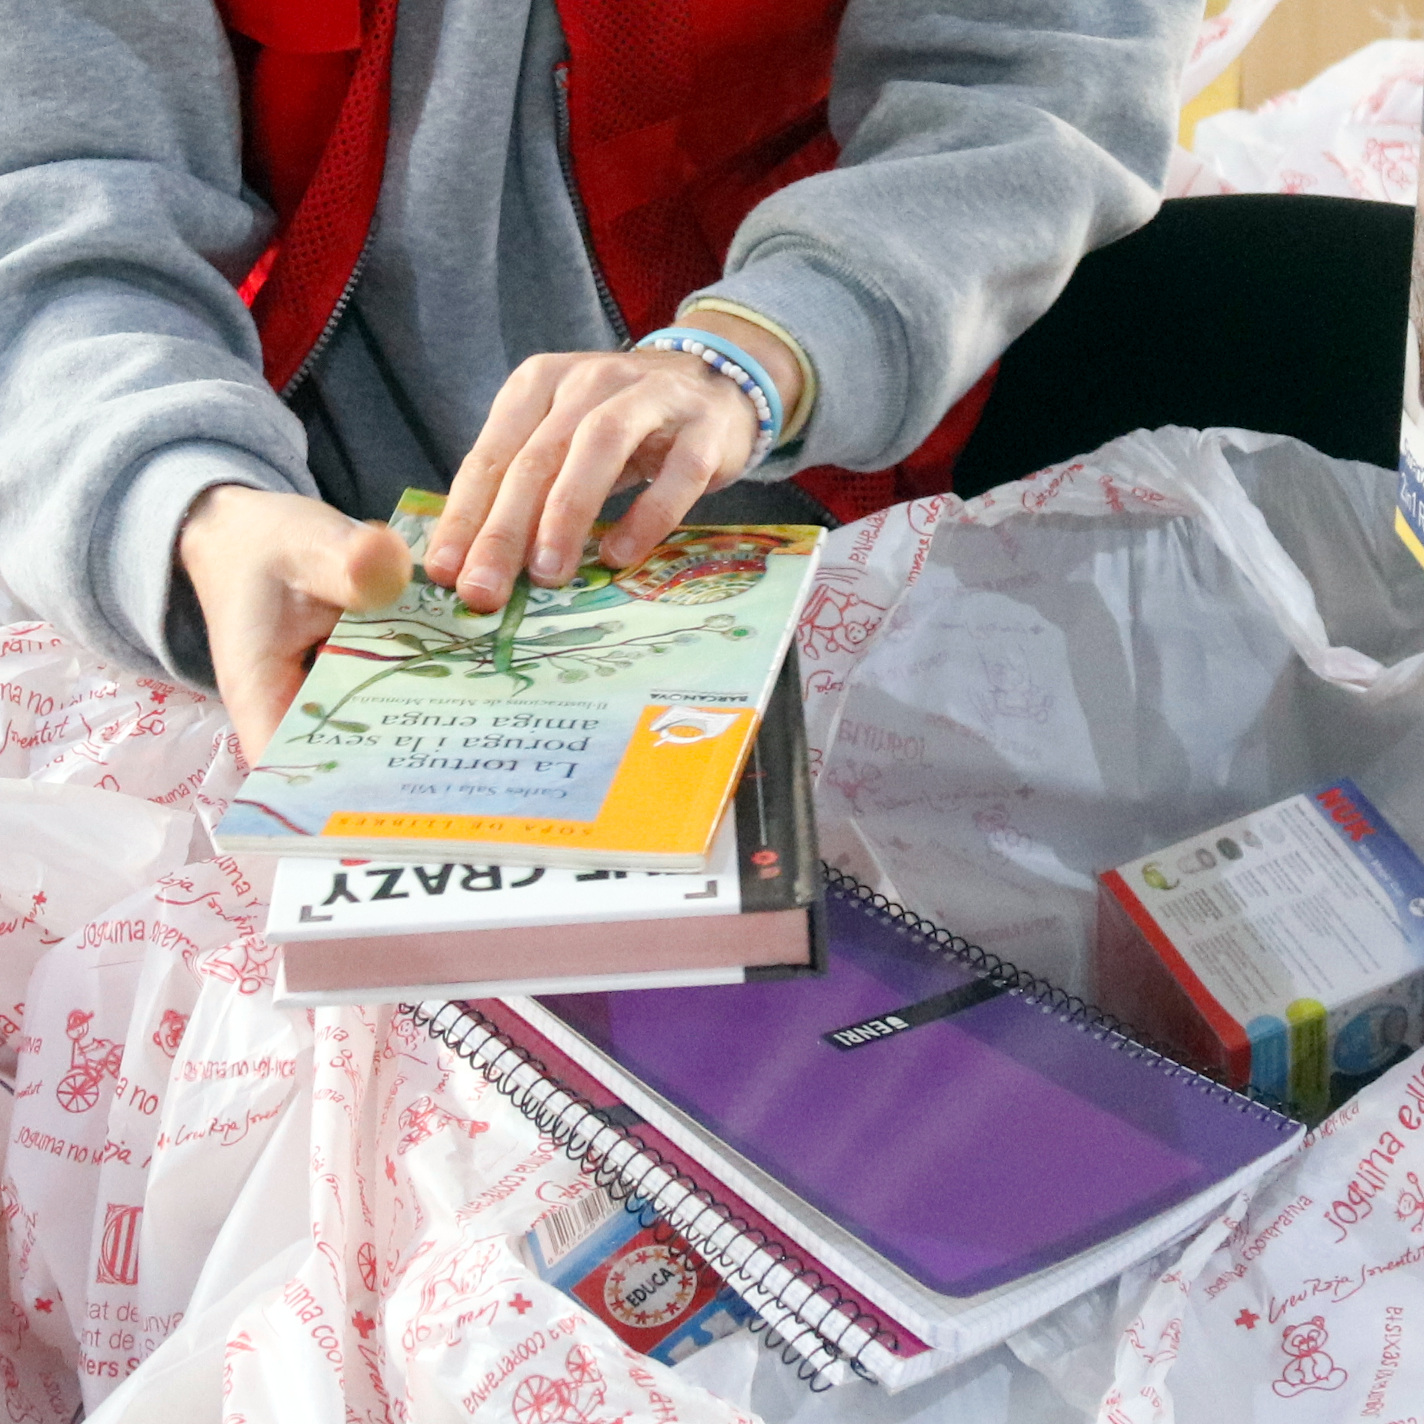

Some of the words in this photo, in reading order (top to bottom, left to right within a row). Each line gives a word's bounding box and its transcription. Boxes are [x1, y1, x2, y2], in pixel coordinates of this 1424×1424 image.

[426, 697, 476, 708] Marta
[479, 698, 502, 708] de
[650, 692, 747, 703] BARCANOVA
[380, 711, 477, 731] eruga
[493, 713, 600, 732] amiga
[307, 731, 379, 749] seva
[393, 731, 428, 752] la
[438, 732, 447, 749] i
[463, 735, 590, 753] poruga
[387, 755, 518, 775] tortuga
[534, 759, 580, 780] La
[399, 782, 438, 796] Vila
[457, 784, 500, 798] Sala
[506, 785, 568, 800] Carles
[337, 816, 453, 831] LLIBRES
[1315, 786, 1376, 842] NUK
[472, 820, 505, 833] DE
[522, 822, 593, 838] SOPA
[76, 919, 145, 950] joguina
[832, 1019, 894, 1047] ENRI
[13, 1125, 64, 1156] joguina
[64, 1138, 90, 1164] no
[1322, 1127, 1406, 1245] joguina
[1242, 1194, 1315, 1265] cooperativa
[626, 1266, 675, 1309] EDUCA
[1267, 1289, 1310, 1325] Creu
[1302, 1275, 1353, 1306] Roja
[462, 1328, 548, 1415] cooperativa
